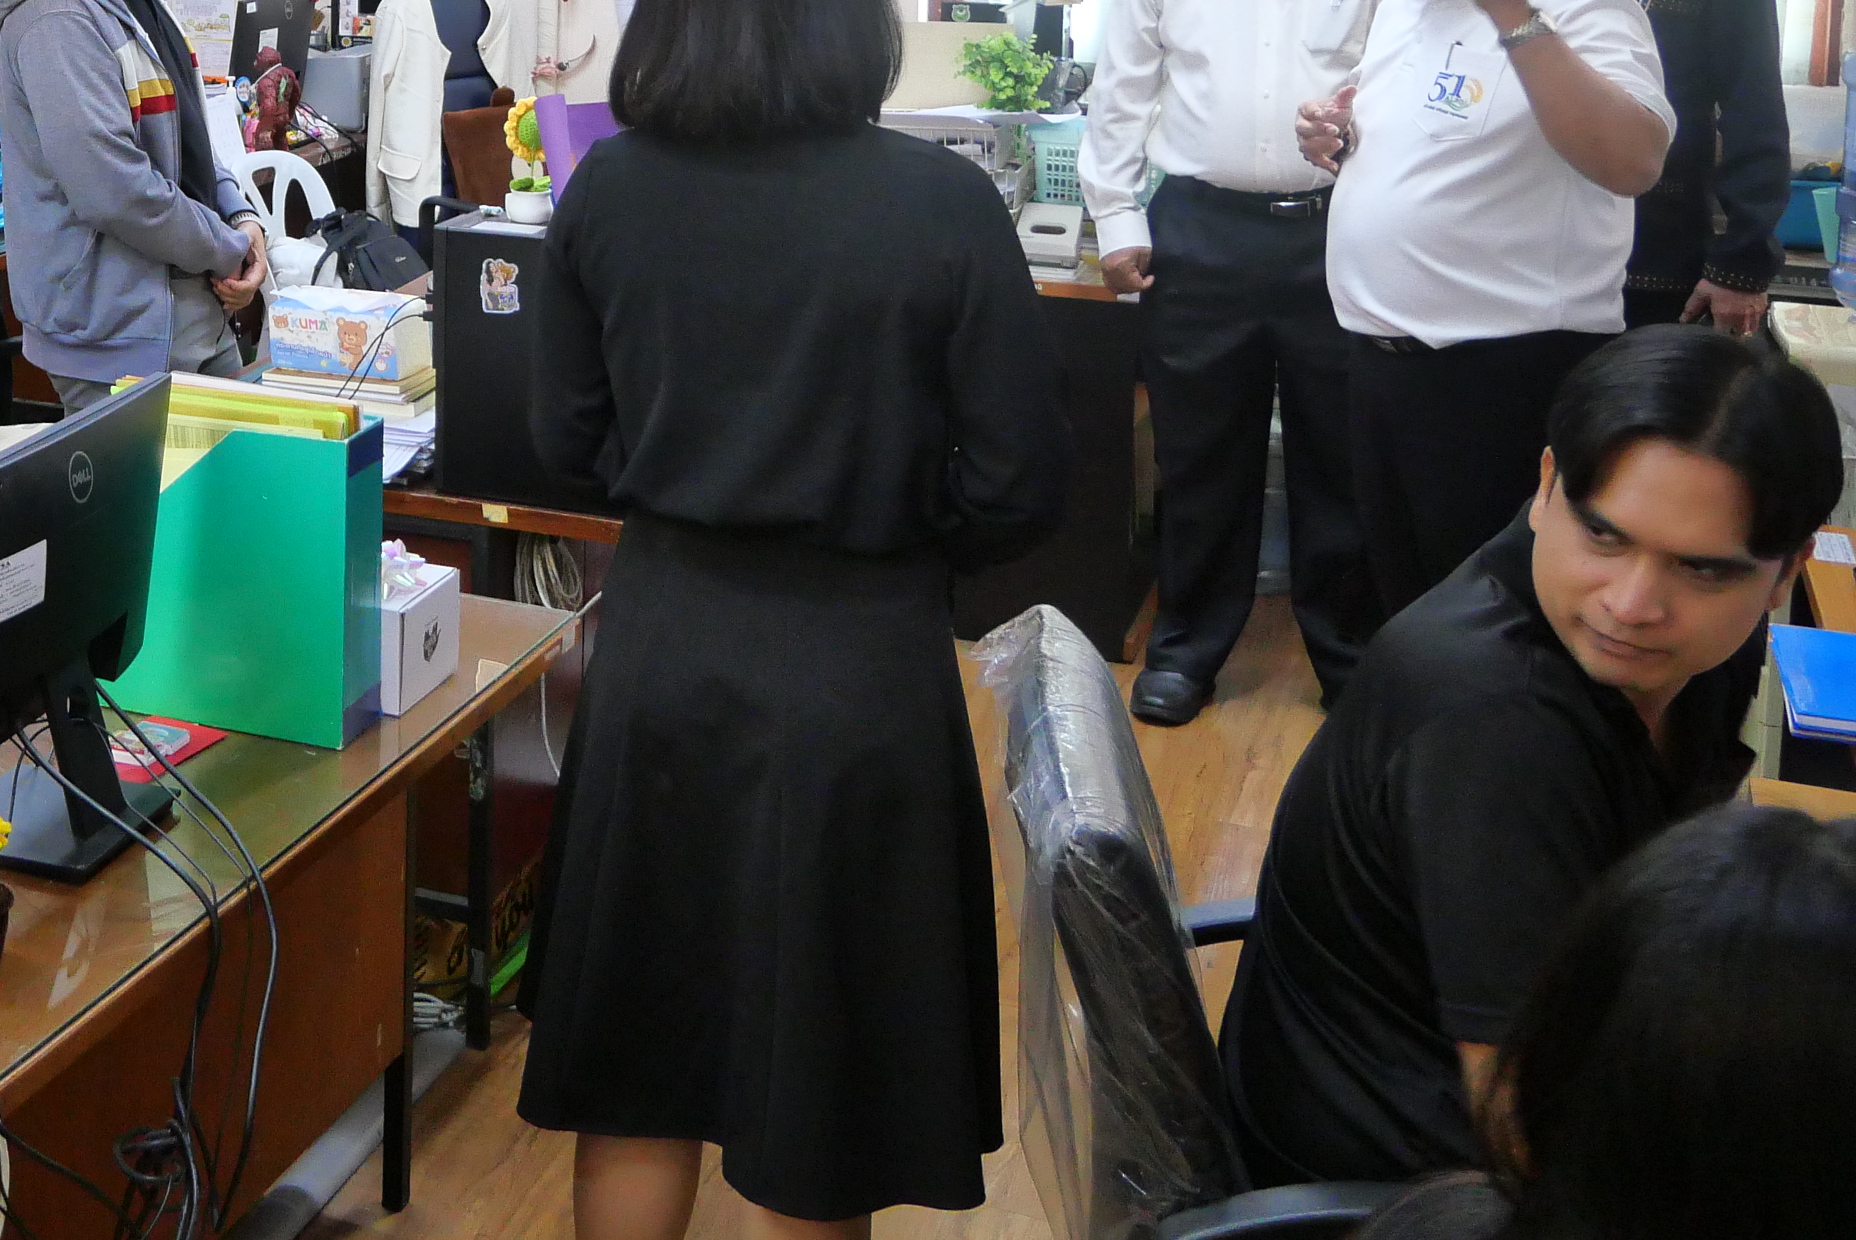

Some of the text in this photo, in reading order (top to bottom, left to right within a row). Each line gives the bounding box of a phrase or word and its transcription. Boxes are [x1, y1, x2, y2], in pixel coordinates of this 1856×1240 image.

[1428, 72, 1465, 102] 51
[291, 317, 328, 332] KUMA
[72, 468, 91, 488] DELL
